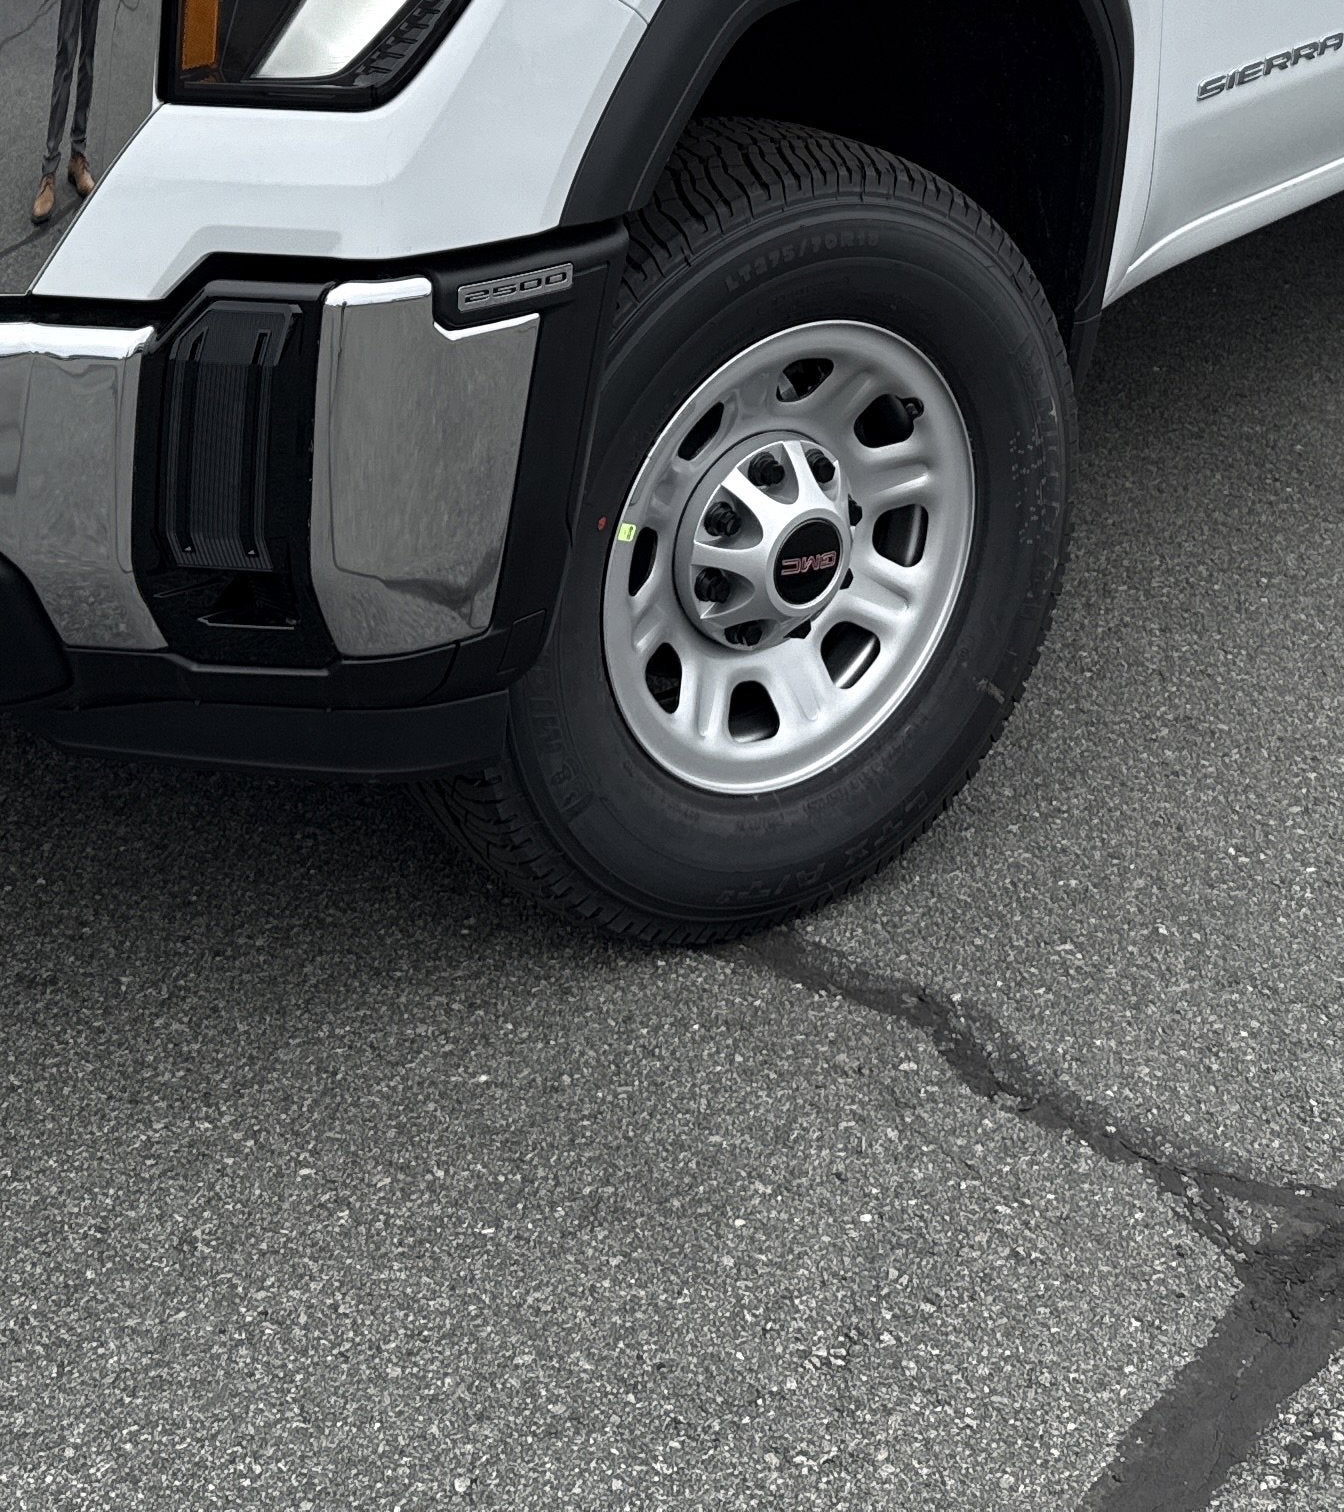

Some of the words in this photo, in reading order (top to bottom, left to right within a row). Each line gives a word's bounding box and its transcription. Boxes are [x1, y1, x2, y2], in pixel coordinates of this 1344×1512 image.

[1196, 32, 1344, 101] SIERRA
[464, 272, 567, 303] 2500
[781, 551, 836, 575] GMC
